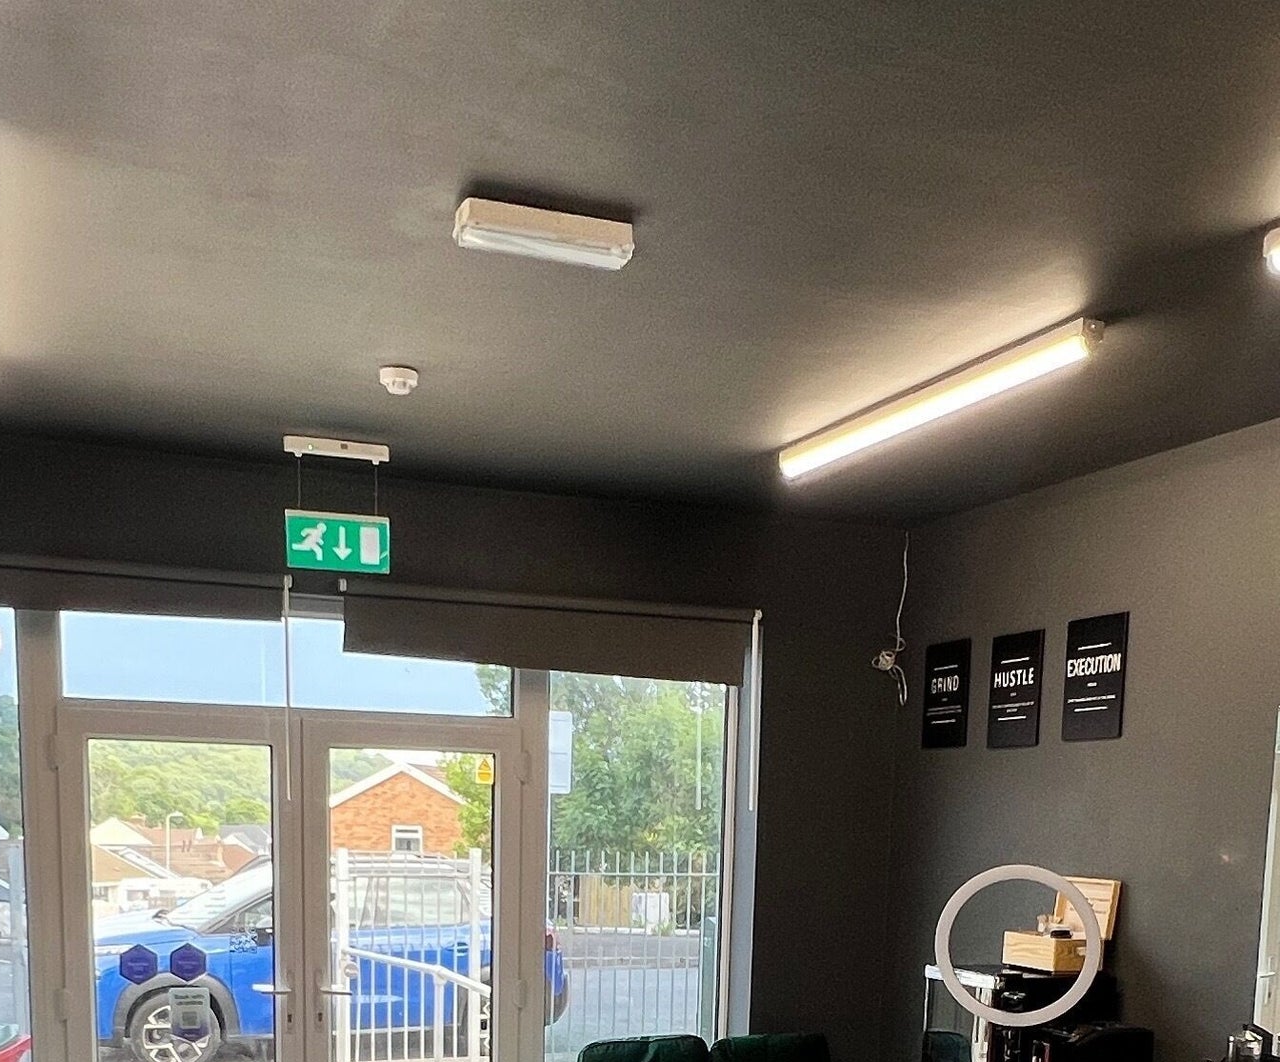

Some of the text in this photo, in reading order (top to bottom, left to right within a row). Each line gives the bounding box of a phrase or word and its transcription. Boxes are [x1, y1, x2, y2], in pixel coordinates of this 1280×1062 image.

[1066, 653, 1122, 678] EXECUTION
[931, 675, 960, 694] GRIND
[993, 667, 1035, 689] HUSTLE
